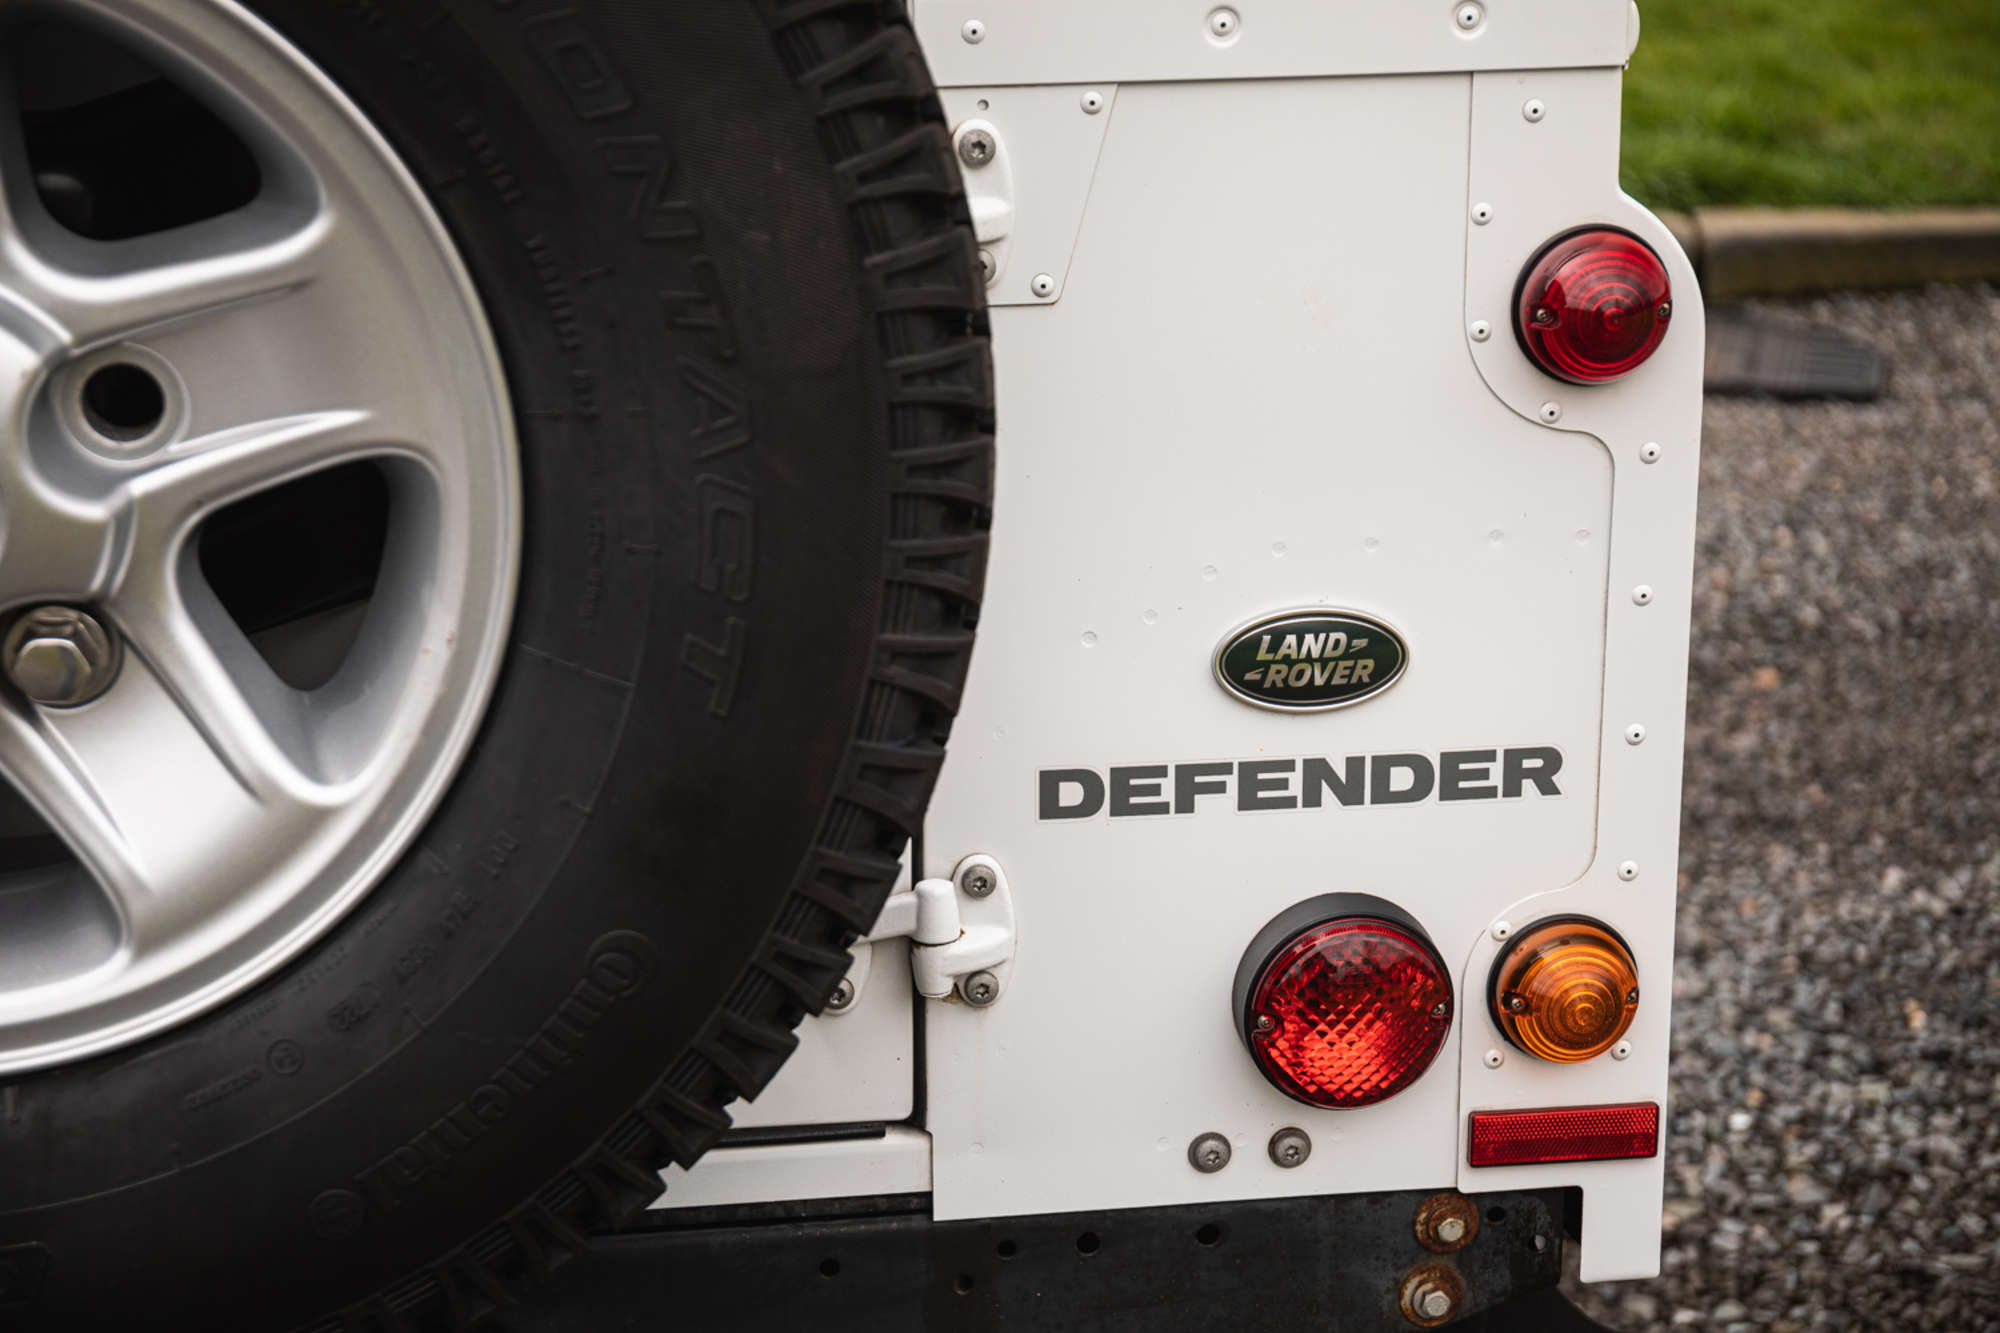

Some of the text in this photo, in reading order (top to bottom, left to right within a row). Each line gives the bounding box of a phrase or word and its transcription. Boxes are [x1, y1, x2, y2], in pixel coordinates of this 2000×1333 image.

[495, 0, 751, 718] ONTACT
[1256, 632, 1347, 661] LAND
[1263, 659, 1375, 688] ROVER
[1038, 746, 1564, 821] DEFENDER
[354, 929, 661, 1207] Continental
